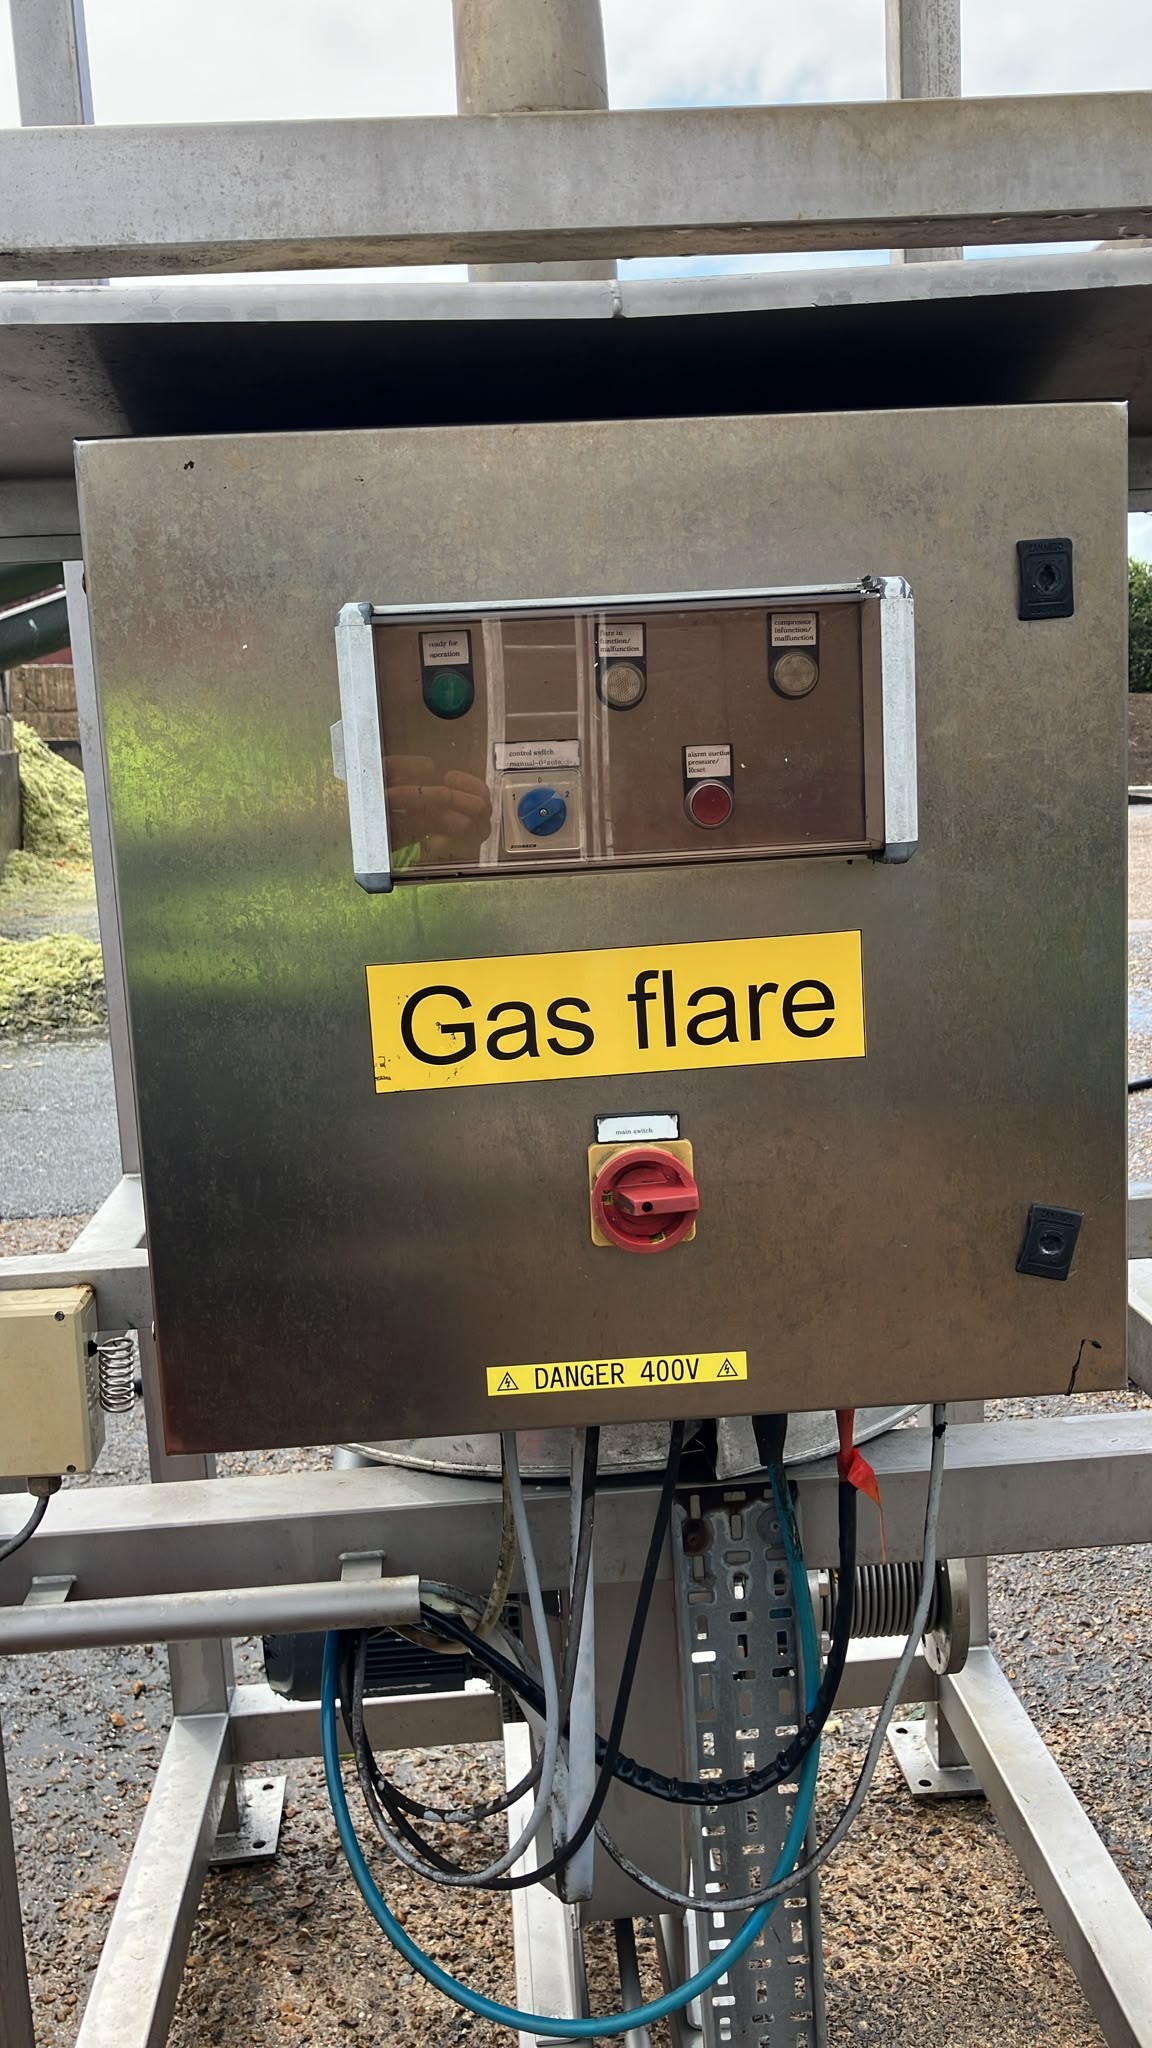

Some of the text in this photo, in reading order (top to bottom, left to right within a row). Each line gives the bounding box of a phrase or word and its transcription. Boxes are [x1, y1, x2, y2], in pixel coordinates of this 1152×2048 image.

[448, 639, 459, 647] for
[533, 748, 555, 756] switch
[687, 758, 720, 766] pressure/
[565, 790, 570, 798] 2
[401, 970, 836, 1066] Gas flare
[633, 1127, 653, 1135] switch
[535, 1359, 699, 1390] DANGER 400V
